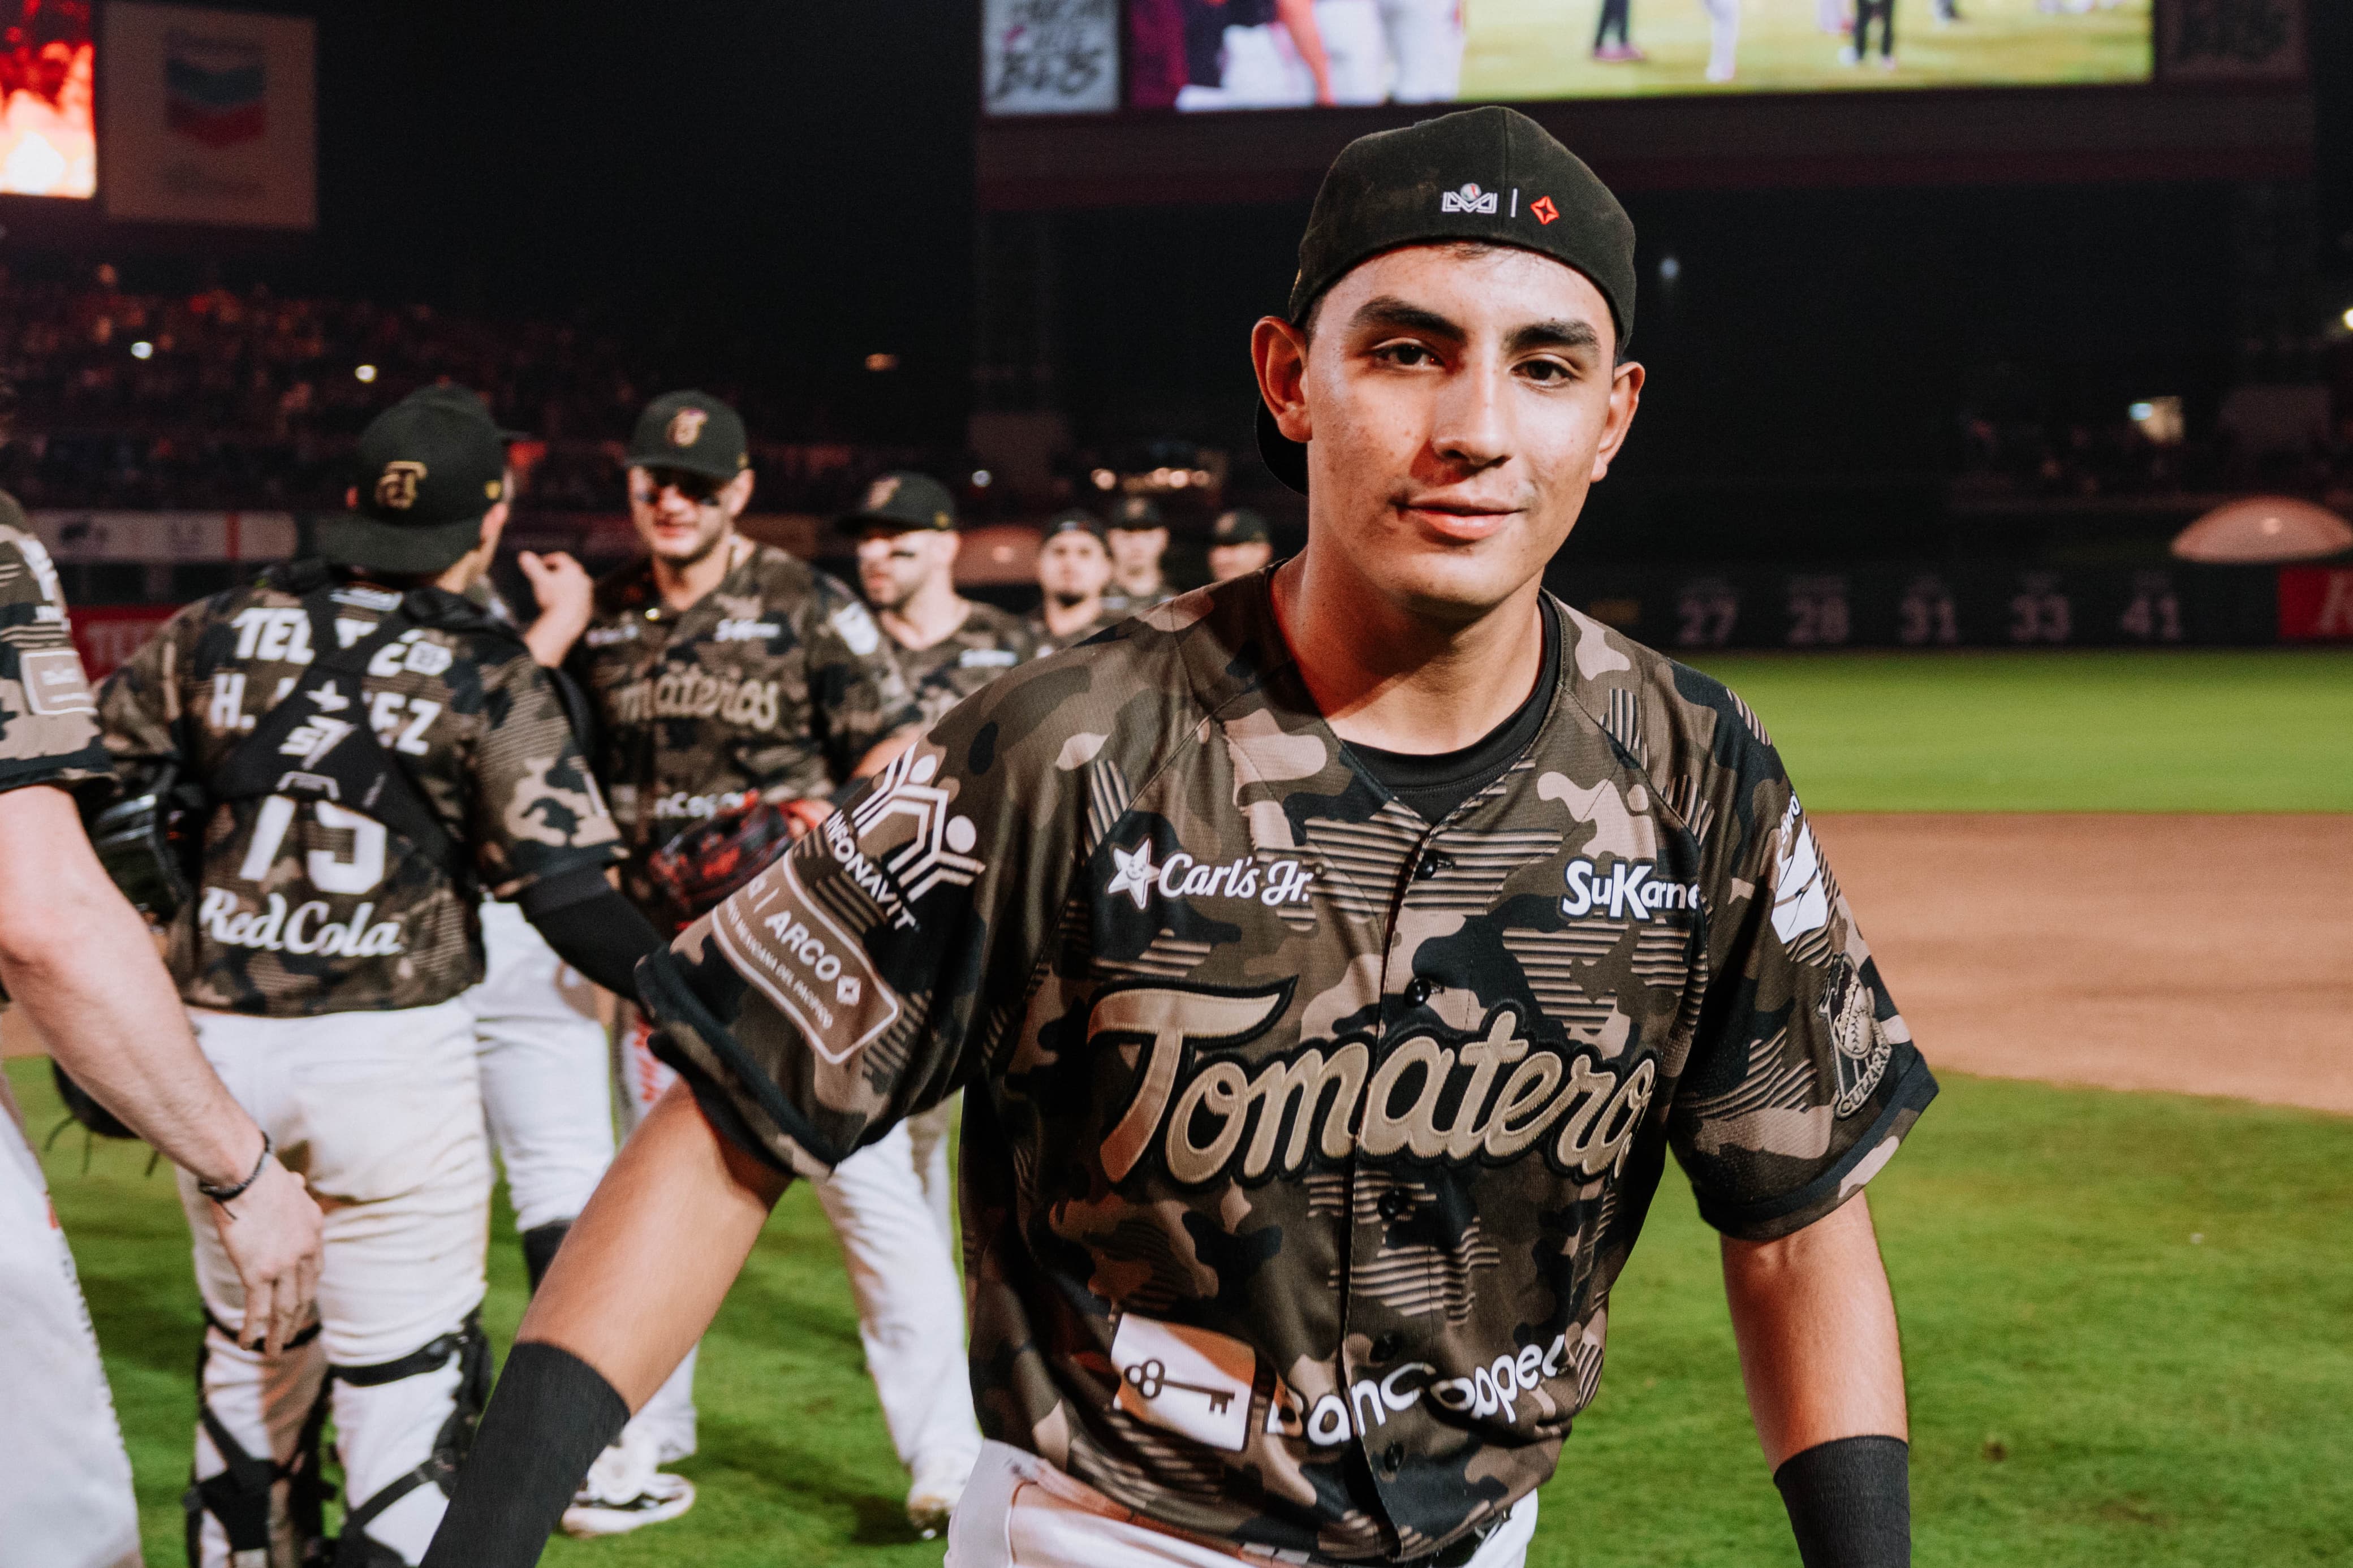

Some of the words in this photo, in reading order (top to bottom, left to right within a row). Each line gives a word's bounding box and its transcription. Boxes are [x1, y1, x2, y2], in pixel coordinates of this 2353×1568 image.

[825, 809, 917, 931] INFONAVIT
[1158, 852, 1261, 898] Carl's
[1261, 860, 1315, 905] Jr.
[765, 910, 842, 982] ARCO
[1087, 976, 1655, 1185] Tomatero
